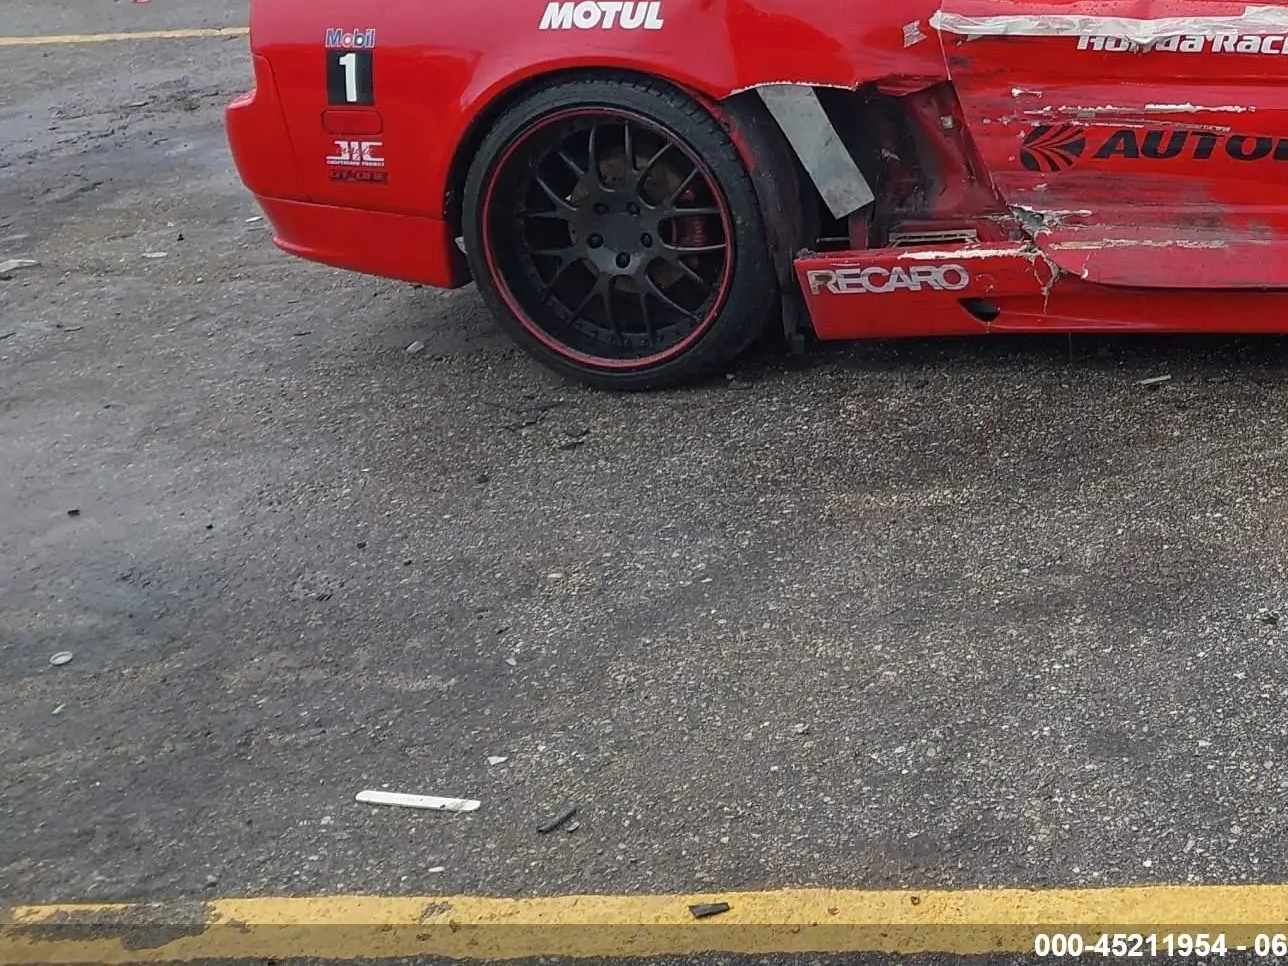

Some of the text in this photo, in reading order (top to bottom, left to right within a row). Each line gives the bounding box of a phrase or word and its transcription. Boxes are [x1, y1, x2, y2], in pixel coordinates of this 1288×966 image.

[538, 0, 664, 30] MOTUL
[325, 28, 376, 49] Mobil
[339, 52, 357, 103] 1
[806, 263, 970, 295] RECARO
